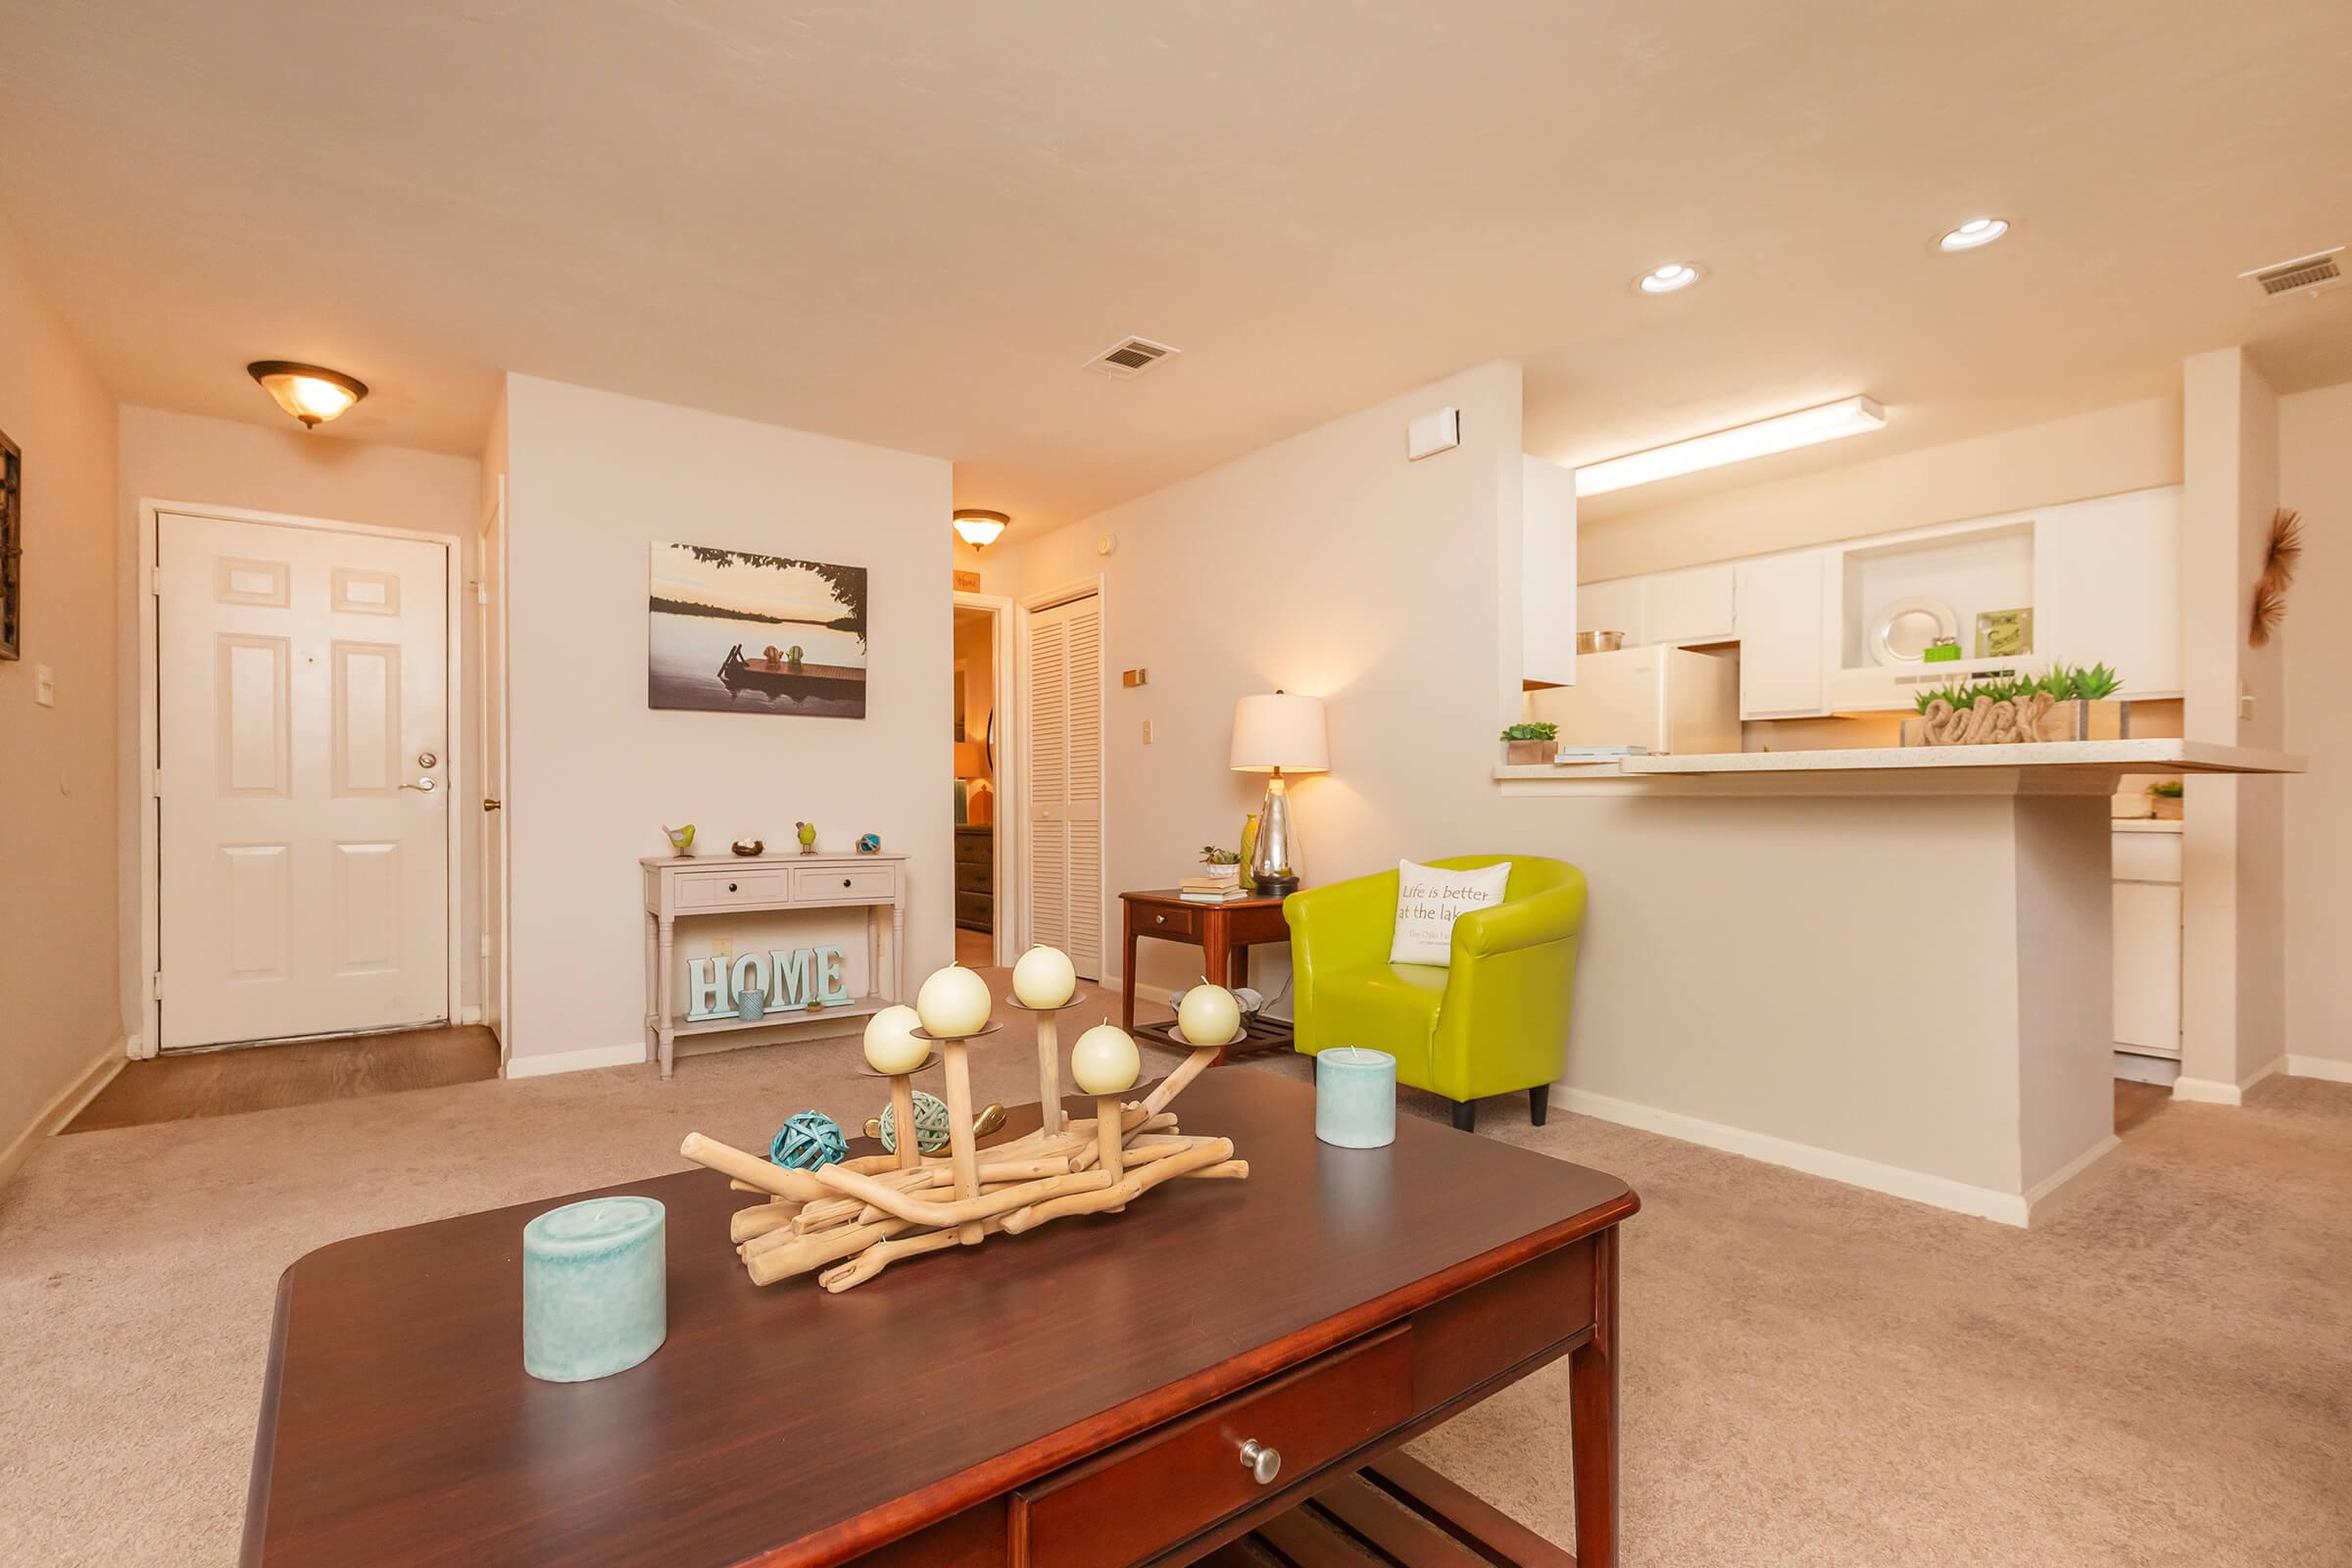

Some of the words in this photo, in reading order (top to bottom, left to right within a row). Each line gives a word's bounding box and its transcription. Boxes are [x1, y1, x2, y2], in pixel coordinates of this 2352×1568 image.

[1402, 883, 1426, 899] Life
[1428, 886, 1439, 899] is
[1443, 885, 1490, 902] better
[1398, 905, 1409, 920] at
[1413, 903, 1436, 920] the
[1440, 904, 1460, 921] lak
[686, 945, 848, 1015] HOME
